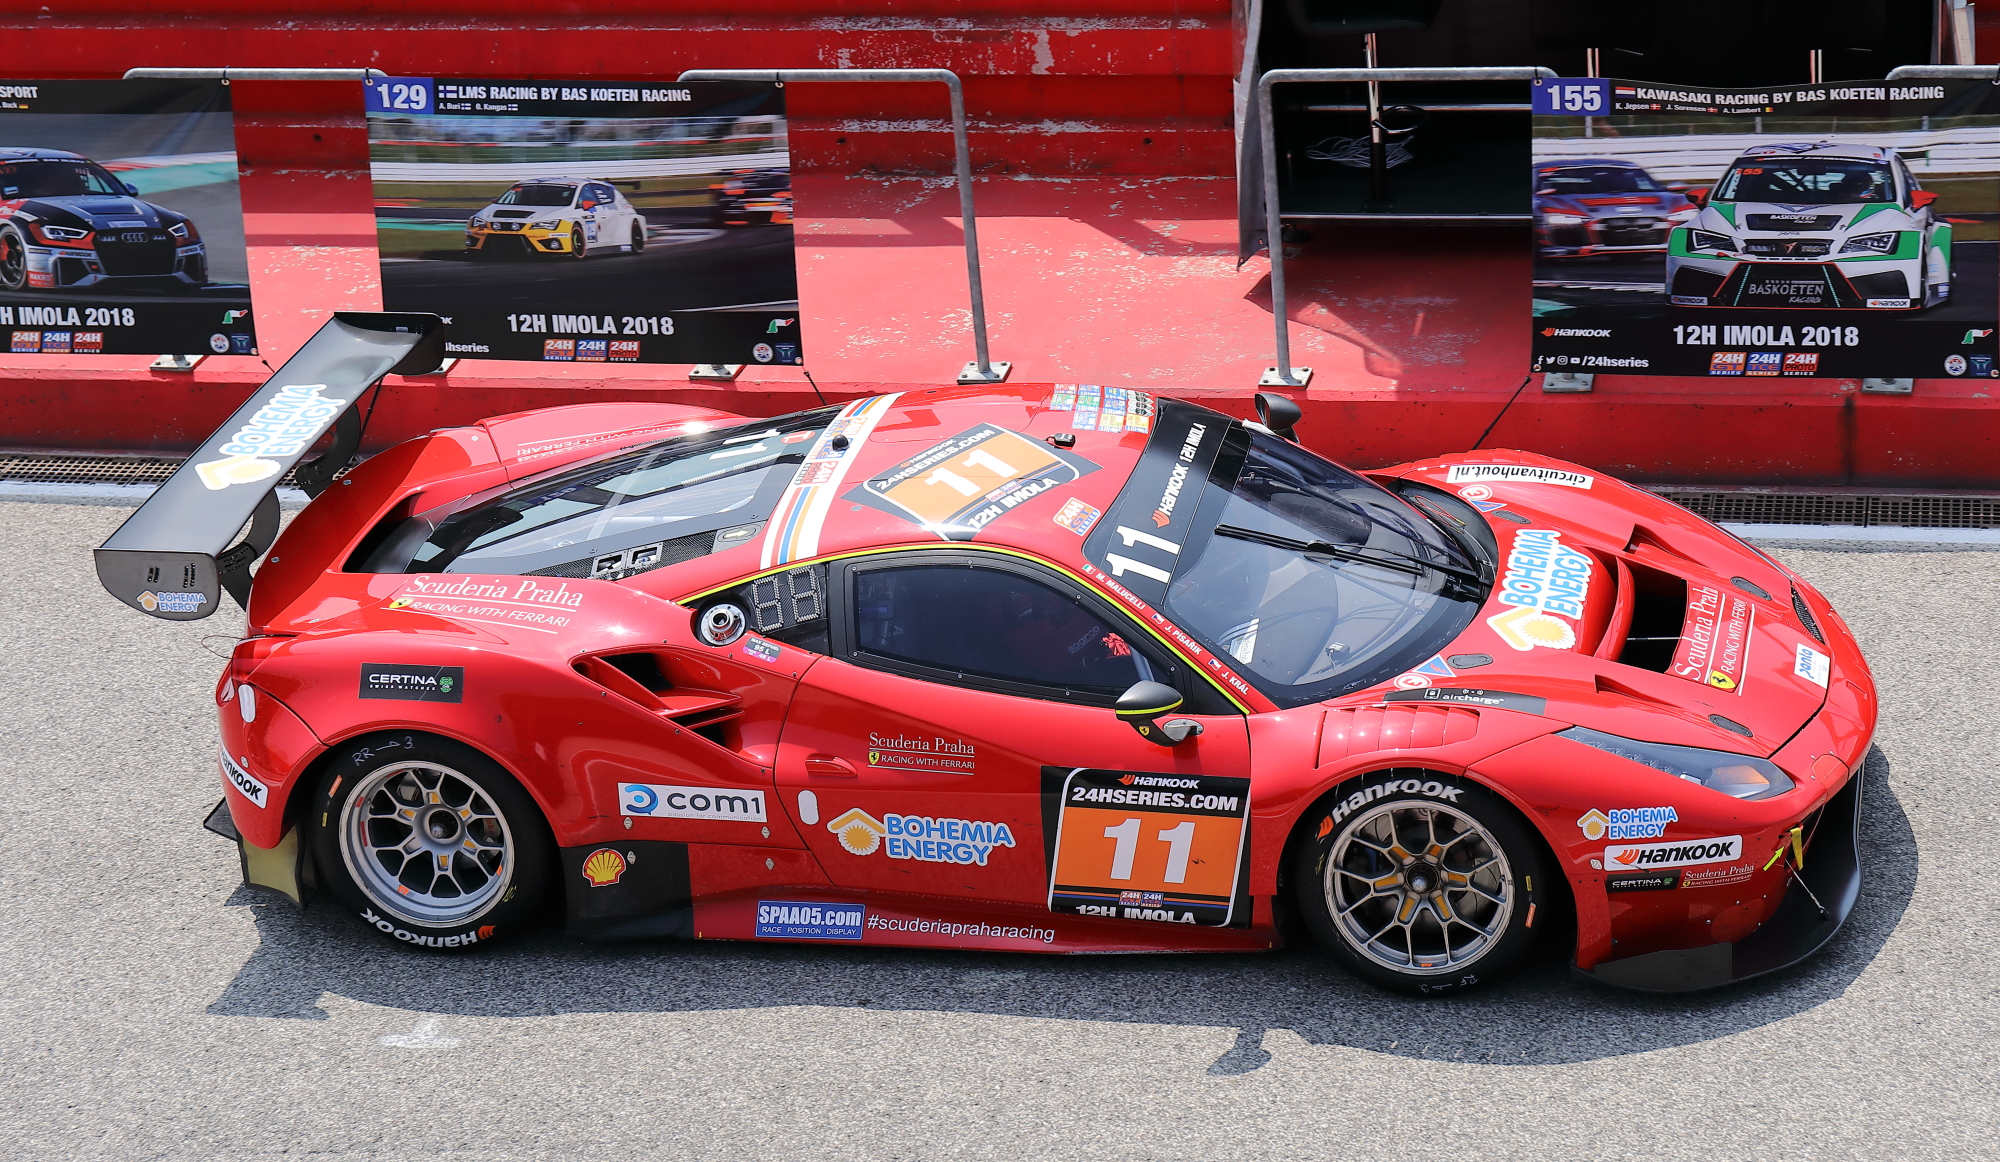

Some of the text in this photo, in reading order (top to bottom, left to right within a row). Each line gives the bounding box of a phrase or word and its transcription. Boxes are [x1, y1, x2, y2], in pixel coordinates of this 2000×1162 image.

[377, 84, 427, 110] 129
[459, 86, 692, 102] LMS RACING BY BAS KOETEN RACING
[1547, 85, 1601, 111] 155
[1637, 86, 1945, 105] KAWASAKI RACING BY BAS KOETEN RACING
[484, 104, 507, 112] Kangas
[1624, 102, 1650, 111] Jepsen
[1749, 283, 1824, 295] BASKOETEN
[18, 307, 81, 326] IMOLA
[85, 308, 135, 326] 2018
[507, 314, 675, 335] 12H IMOLA 2018
[13, 332, 39, 341] 24H
[44, 333, 70, 342] 24H
[75, 333, 101, 342] 24H
[546, 340, 573, 350] 24H
[578, 341, 606, 350] 24H
[1673, 325, 1859, 346] 12H IMOLA 2018
[611, 342, 638, 351] 24H
[1582, 355, 1649, 367] /24hseries
[1713, 353, 1745, 363] 24H
[1750, 354, 1781, 364] 24H
[1786, 354, 1817, 364] 24H
[225, 386, 322, 454] BOHEMIA
[262, 398, 341, 454] ENERGY
[1179, 444, 1197, 463] 12H
[1188, 422, 1207, 449] IMOLA
[876, 429, 995, 490] 24HSERIES.COM
[924, 448, 1020, 498] 11
[1454, 465, 1586, 486] circuitvanhout.nl
[967, 505, 1004, 529] 12H
[1000, 478, 1060, 508] IMOLA
[1057, 500, 1084, 525] 24H
[1070, 507, 1089, 528] GT
[1077, 509, 1099, 535] SERIES
[1105, 525, 1181, 584] 11
[1504, 531, 1555, 607] BOHEMIA
[406, 575, 584, 607] Scuderia Praha
[1095, 573, 1146, 610] M. MALUCELLI
[1544, 547, 1588, 616] ENERGY
[159, 593, 206, 603] BOHEMIA
[161, 603, 198, 611] ENERGY
[410, 601, 571, 627] RACING WITH FERRARI
[1068, 626, 1099, 652] sparco
[1164, 625, 1171, 633] J.
[1674, 616, 1714, 681] Scuderia
[1721, 619, 1743, 674] RACING WITH
[369, 674, 438, 685] CERTINA
[1221, 671, 1250, 696] J. KRÁL
[869, 732, 975, 754] Scuderia Praha
[352, 747, 375, 766] RR
[881, 754, 975, 769] RACING WITH FERRARI
[667, 793, 761, 814] com1
[1071, 787, 1239, 811] 24HSERIES.COM
[1610, 808, 1677, 824] BOHEMIA
[887, 817, 1013, 845] BOHEMIA
[1610, 823, 1665, 838] ENERGY
[889, 838, 990, 864] ENERGY
[1103, 818, 1196, 884] 11
[1612, 878, 1661, 886] CERTINA
[1685, 864, 1755, 879] Scuderia Praha
[758, 905, 861, 927] SPAA05.com
[1076, 905, 1197, 925] 12H IMOLA
[762, 926, 857, 936] RACE POSITION DISPLAY
[867, 914, 1055, 944] #scuderiapraharacing
